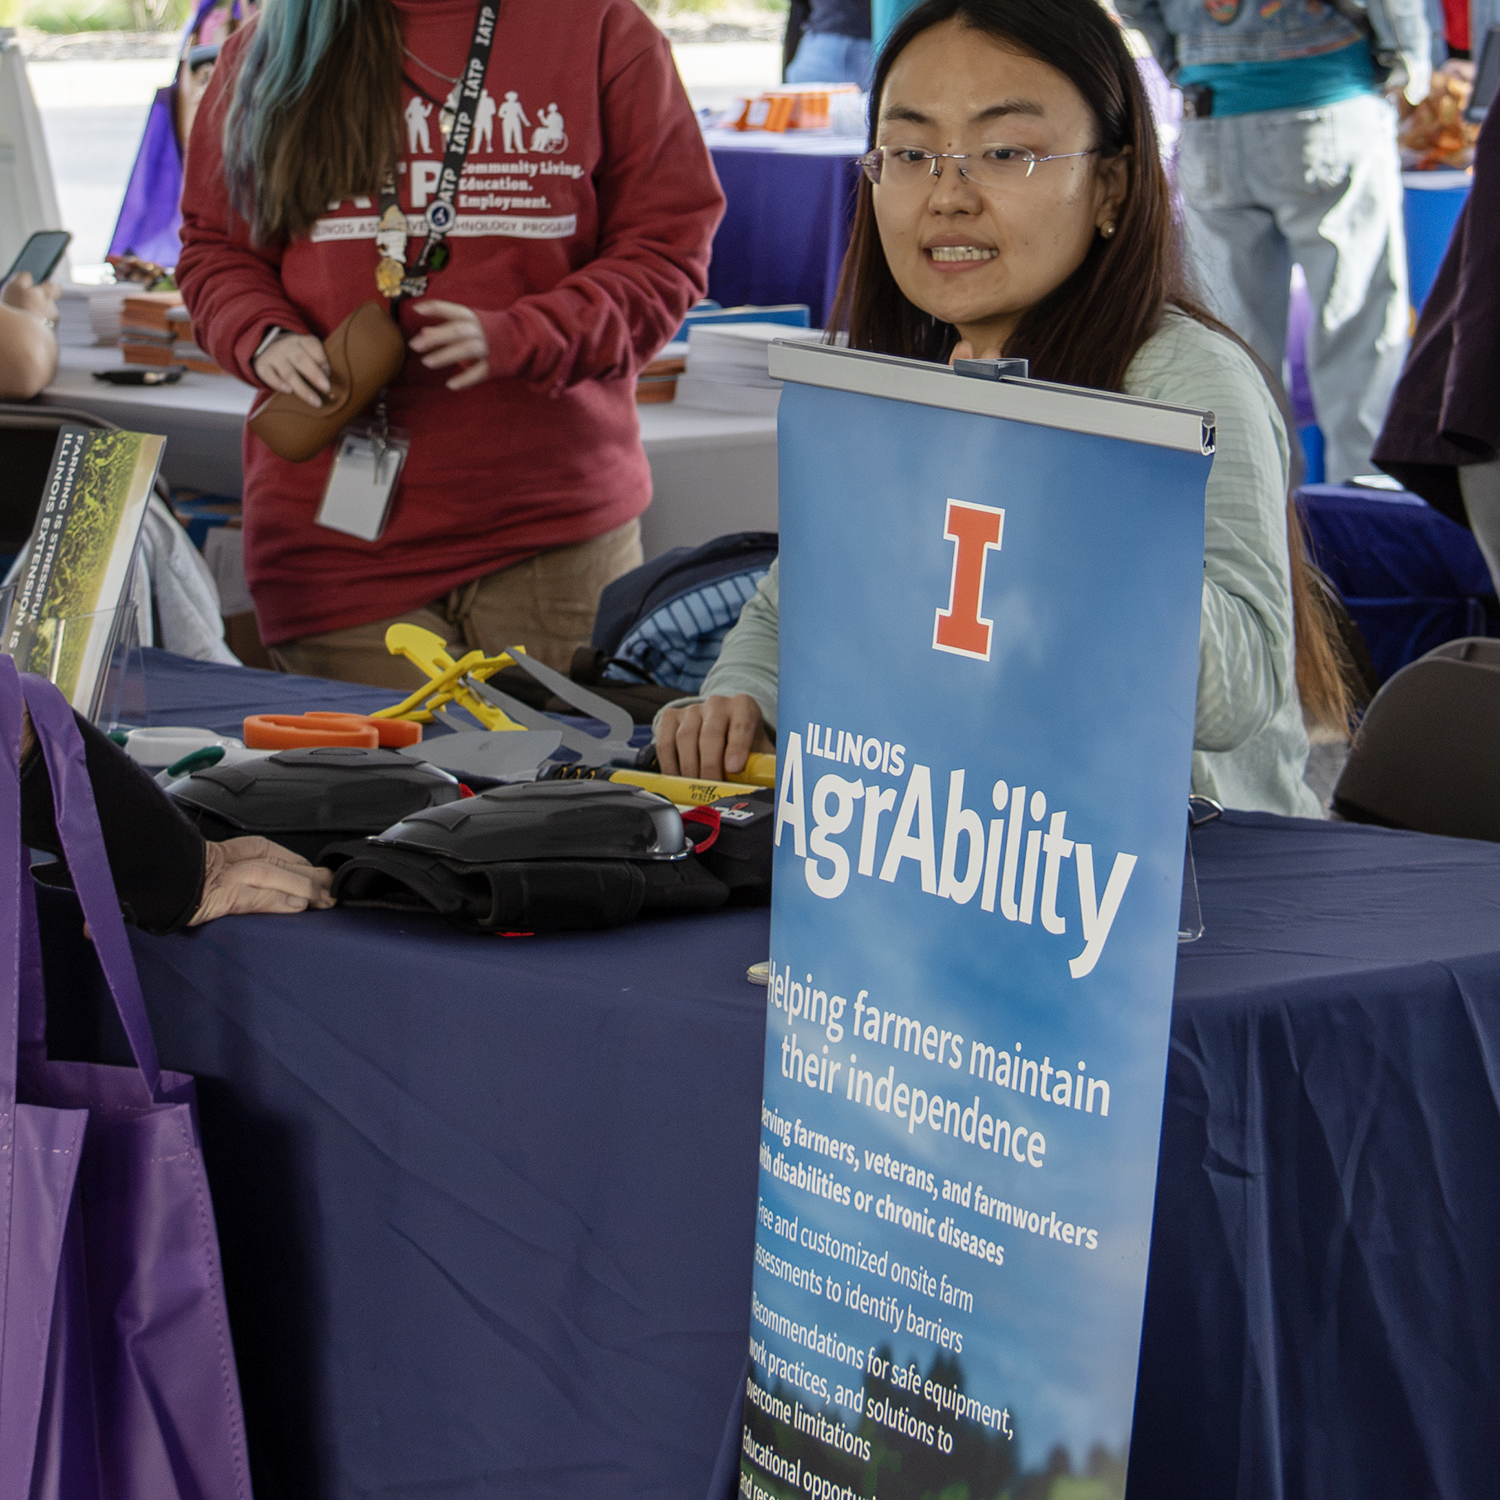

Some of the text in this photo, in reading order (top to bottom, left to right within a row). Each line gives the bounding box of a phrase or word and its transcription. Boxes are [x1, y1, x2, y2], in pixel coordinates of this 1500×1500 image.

[475, 6, 496, 46] IATP
[463, 57, 485, 99] IATP
[450, 111, 473, 155] IATP
[438, 168, 458, 203] ATP
[9, 432, 73, 649] ILLINOIS EXTENSION IS
[28, 434, 85, 624] FARMING IS STRESSFUL
[806, 722, 906, 777] ILLINOIS
[775, 731, 1138, 979] AgrAbility
[767, 958, 1110, 1117] Helping farmers maintain
[782, 1033, 1046, 1168] their independence
[772, 1152, 851, 1206] disabilities
[854, 1189, 873, 1213] or
[875, 1194, 935, 1238] chronic
[938, 1217, 1005, 1266] diseases
[794, 1119, 860, 1172] farmers,
[864, 1149, 939, 1201] veterans,
[942, 1181, 972, 1209] and
[974, 1185, 1099, 1250] farmworkers
[774, 1215, 799, 1243] and
[800, 1227, 889, 1277] customized
[891, 1265, 937, 1298] onsite
[938, 1274, 974, 1313] farm
[826, 1275, 842, 1303] to
[845, 1281, 904, 1333] identify
[906, 1304, 964, 1354] barriers
[746, 1376, 872, 1463] overcome limitations
[767, 1352, 831, 1405] practices,
[834, 1383, 865, 1414] and
[866, 1397, 935, 1447] solutions
[937, 1425, 953, 1455] to
[867, 1347, 890, 1380] for
[891, 1363, 922, 1395] safe
[923, 1379, 1014, 1441] equipment,
[742, 1424, 801, 1488] Educational
